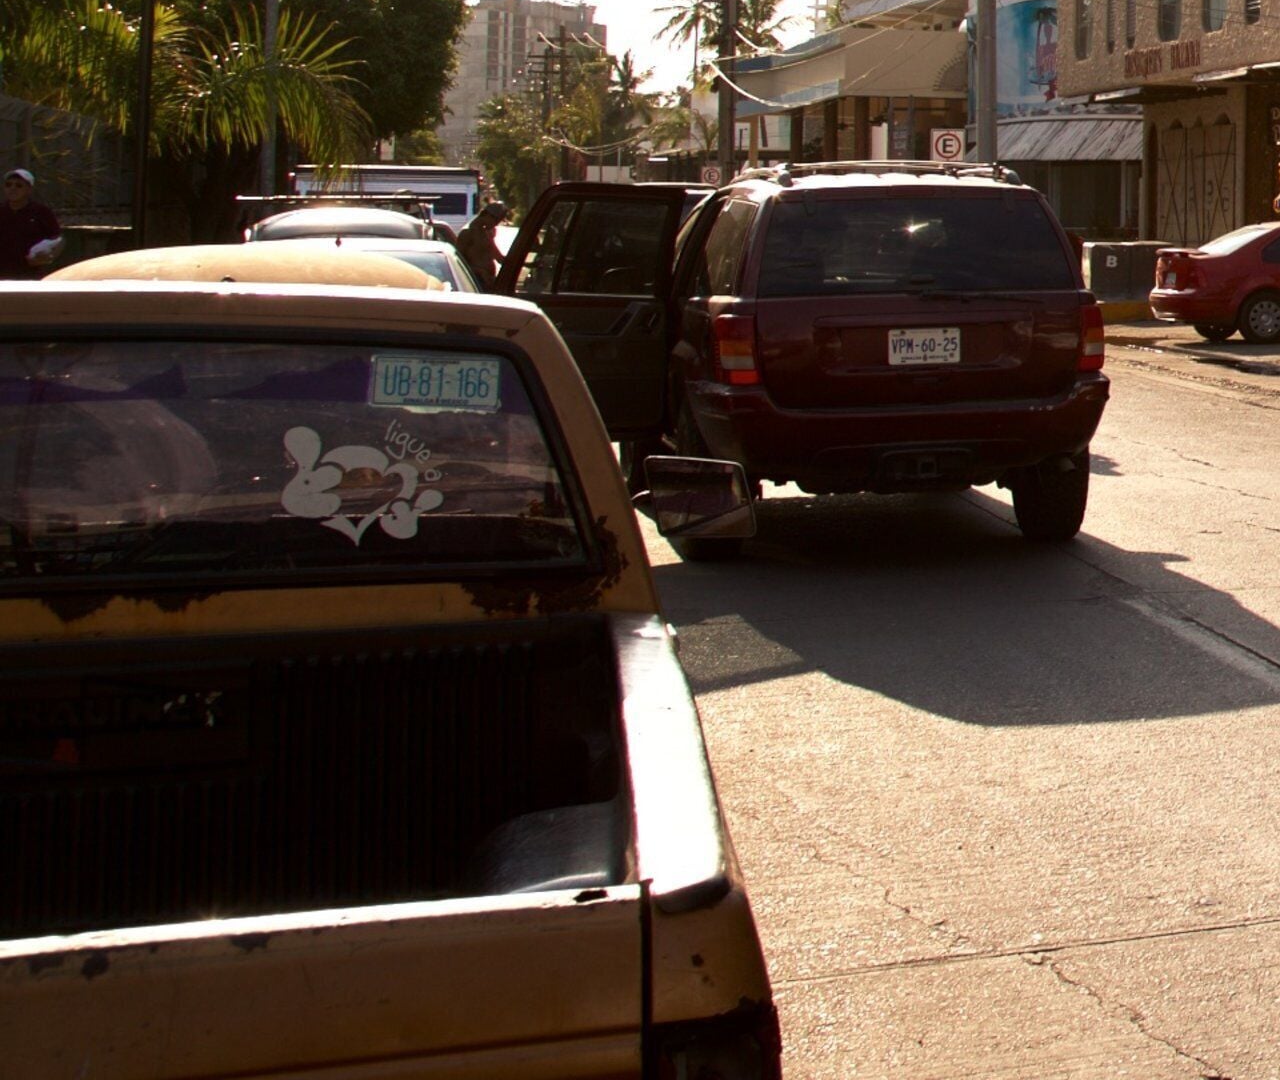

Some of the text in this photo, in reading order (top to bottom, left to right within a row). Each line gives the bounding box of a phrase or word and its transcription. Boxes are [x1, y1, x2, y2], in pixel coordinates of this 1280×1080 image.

[942, 138, 954, 154] E
[1105, 255, 1118, 268] B
[892, 337, 958, 354] VPM-60-25
[383, 364, 490, 398] UB-81-166
